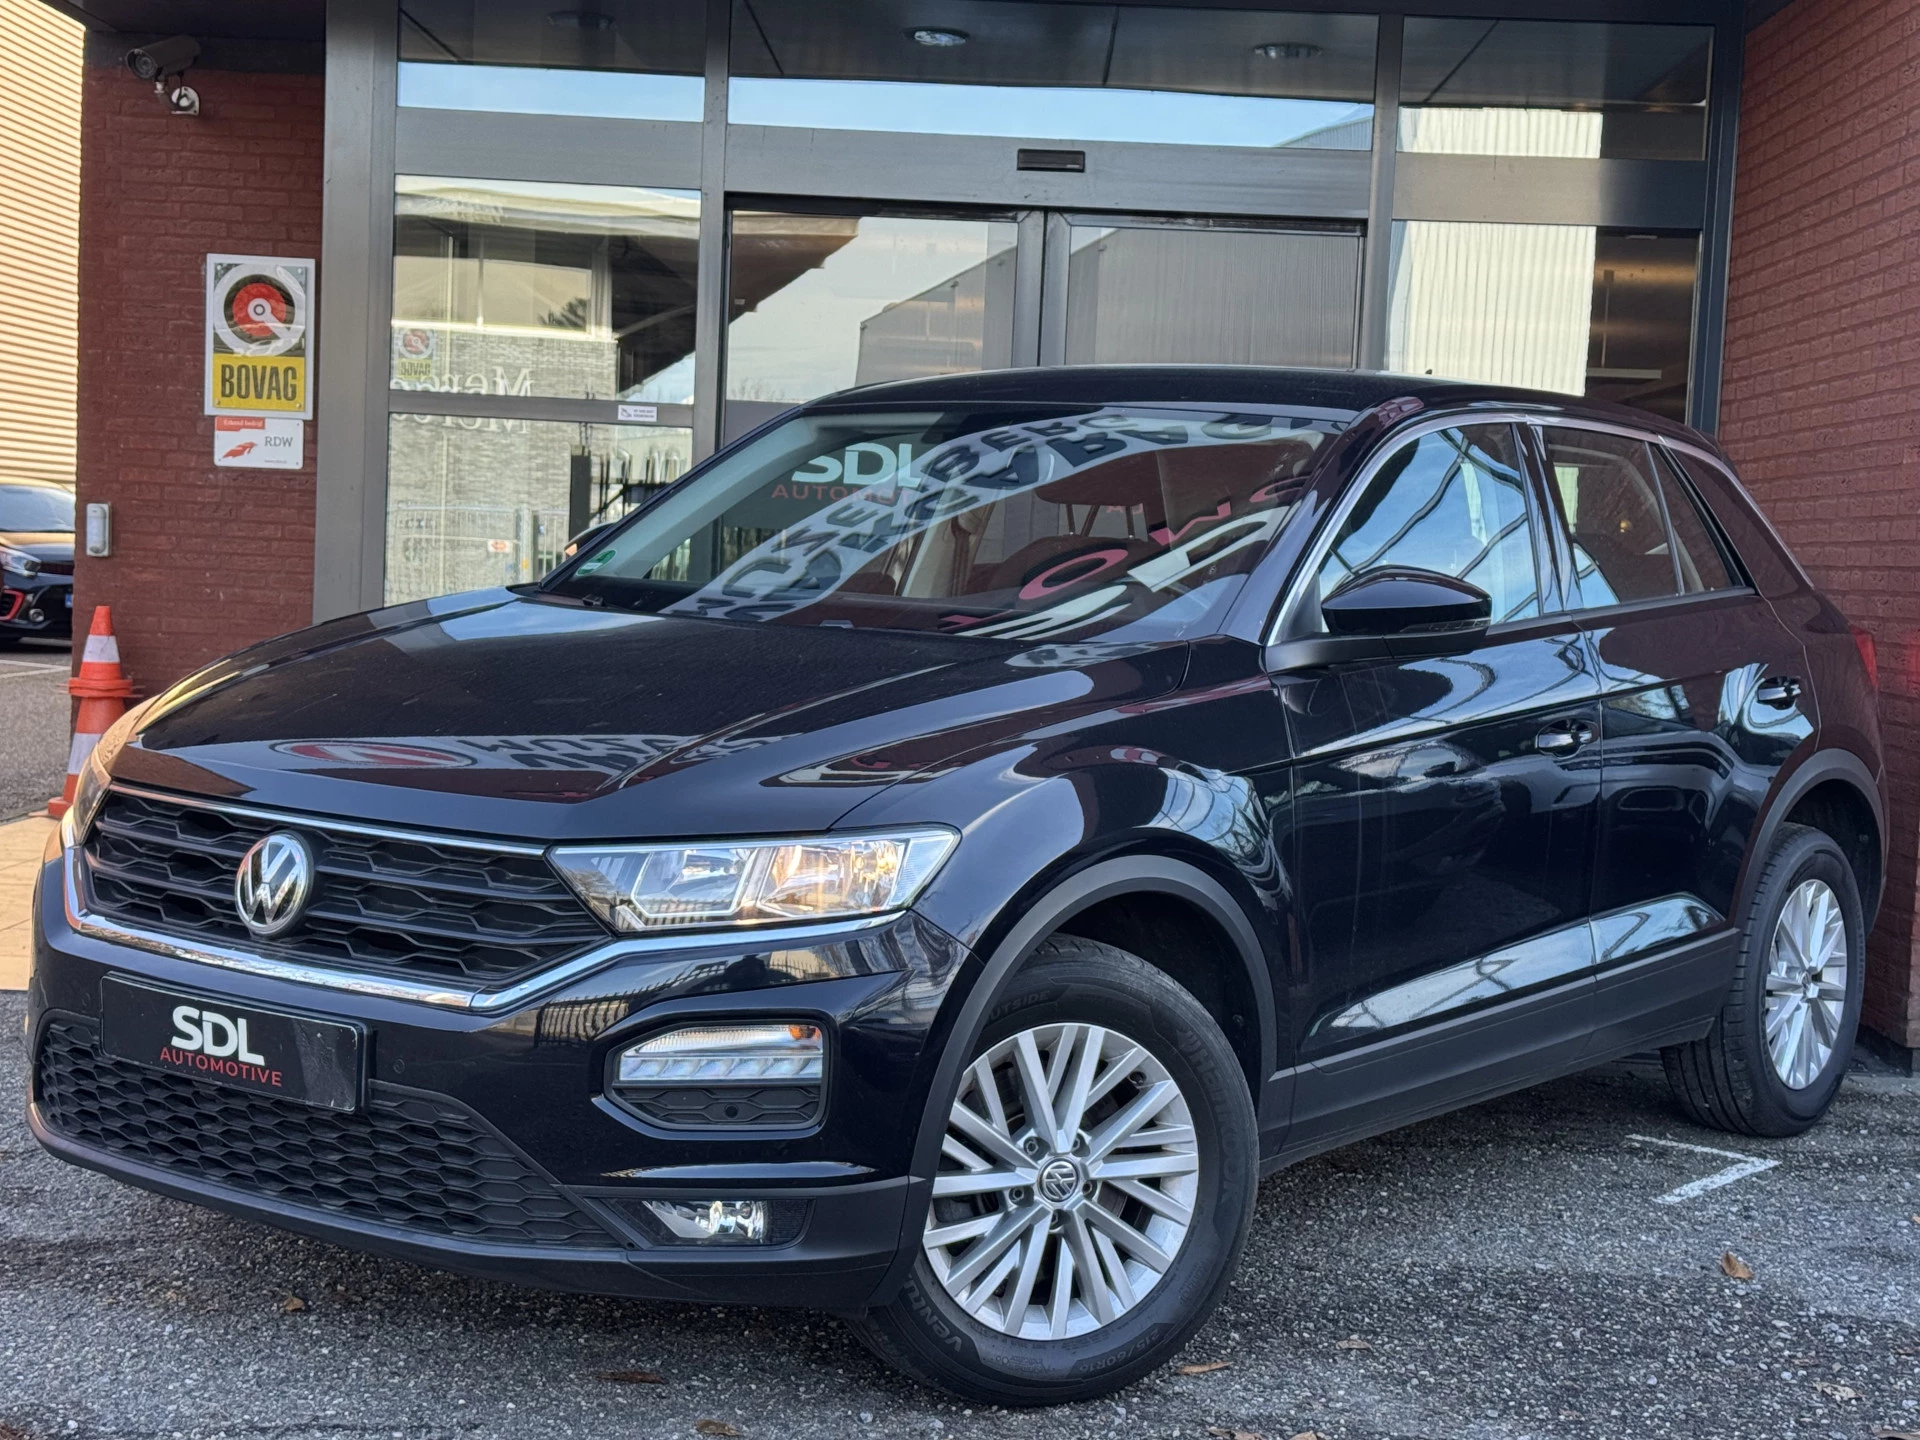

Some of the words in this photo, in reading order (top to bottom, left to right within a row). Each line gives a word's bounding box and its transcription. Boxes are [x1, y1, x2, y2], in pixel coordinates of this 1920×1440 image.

[220, 363, 298, 402] BOVAG
[264, 435, 293, 448] RDW
[791, 442, 922, 488] SDL
[170, 1005, 265, 1067] SDL
[159, 1046, 283, 1088] AUTOMOTIVE
